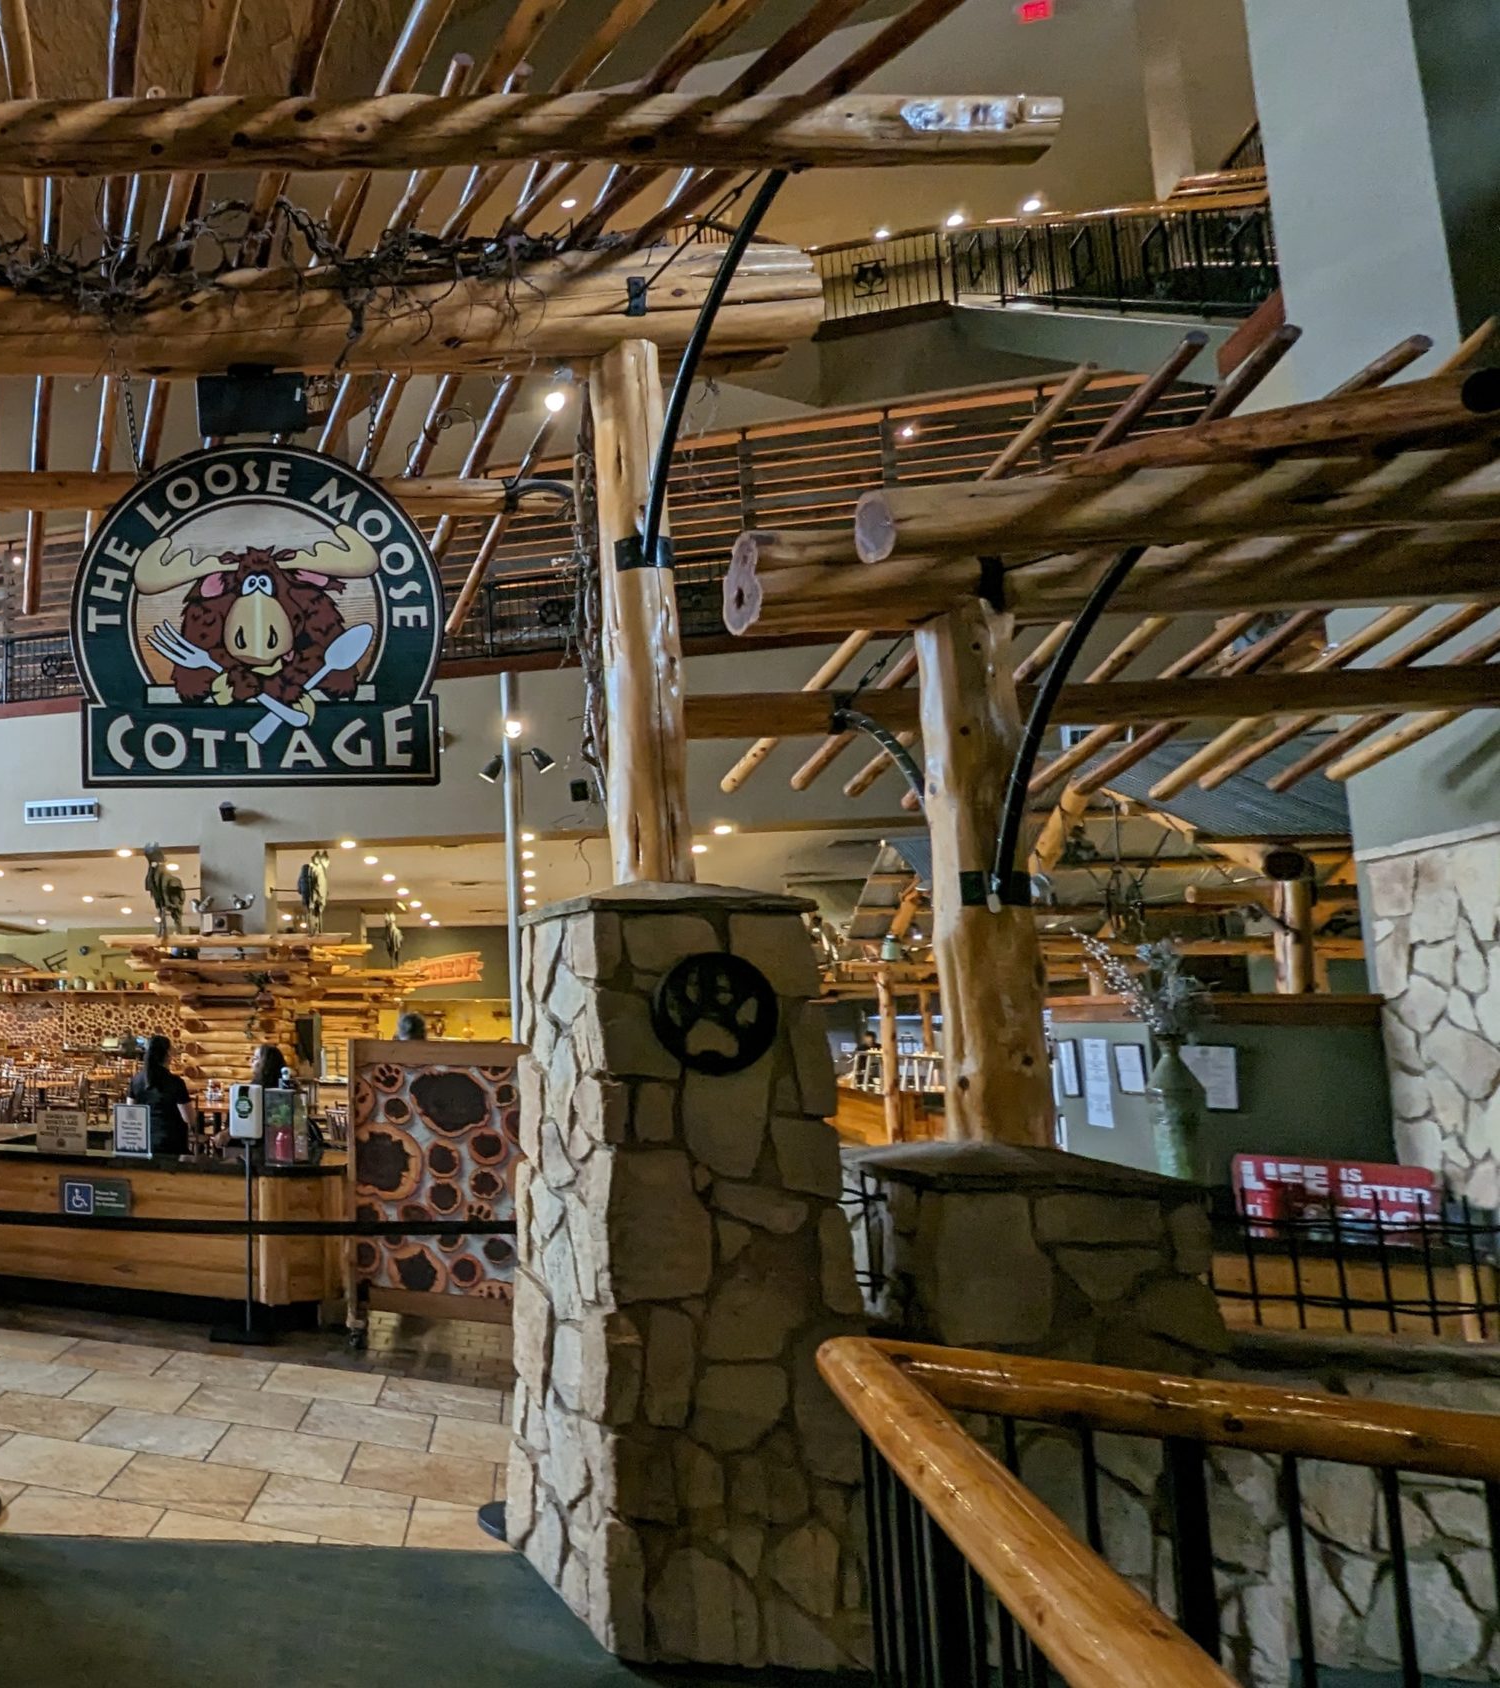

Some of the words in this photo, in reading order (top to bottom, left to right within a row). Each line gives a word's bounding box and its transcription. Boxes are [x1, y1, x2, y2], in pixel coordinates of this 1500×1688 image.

[87, 536, 140, 633] THE
[137, 461, 292, 531] LOOSE
[310, 477, 428, 629] MOOSE
[106, 705, 414, 770] COTTAGE
[1339, 1167, 1363, 1183] IS
[1341, 1184, 1432, 1204] BETTER
